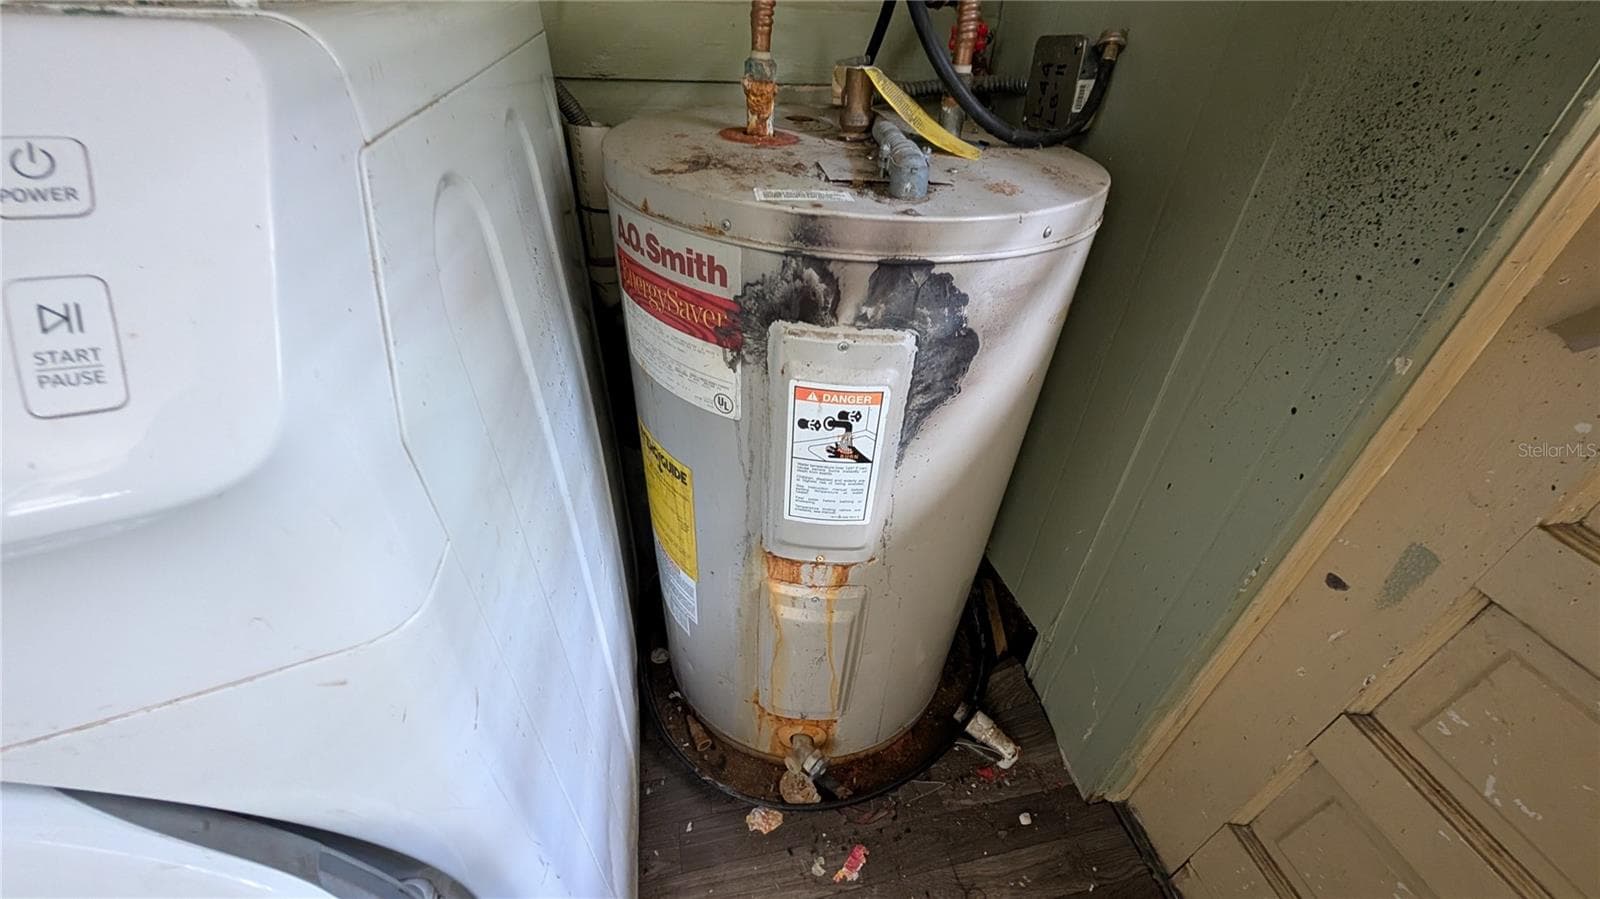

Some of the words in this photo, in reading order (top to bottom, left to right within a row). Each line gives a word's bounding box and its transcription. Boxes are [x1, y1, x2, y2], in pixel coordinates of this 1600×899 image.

[0, 186, 80, 203] POWER
[645, 232, 728, 289] Smith
[33, 347, 102, 367] START
[38, 370, 107, 389] PAUSE
[822, 393, 873, 405] DANGER
